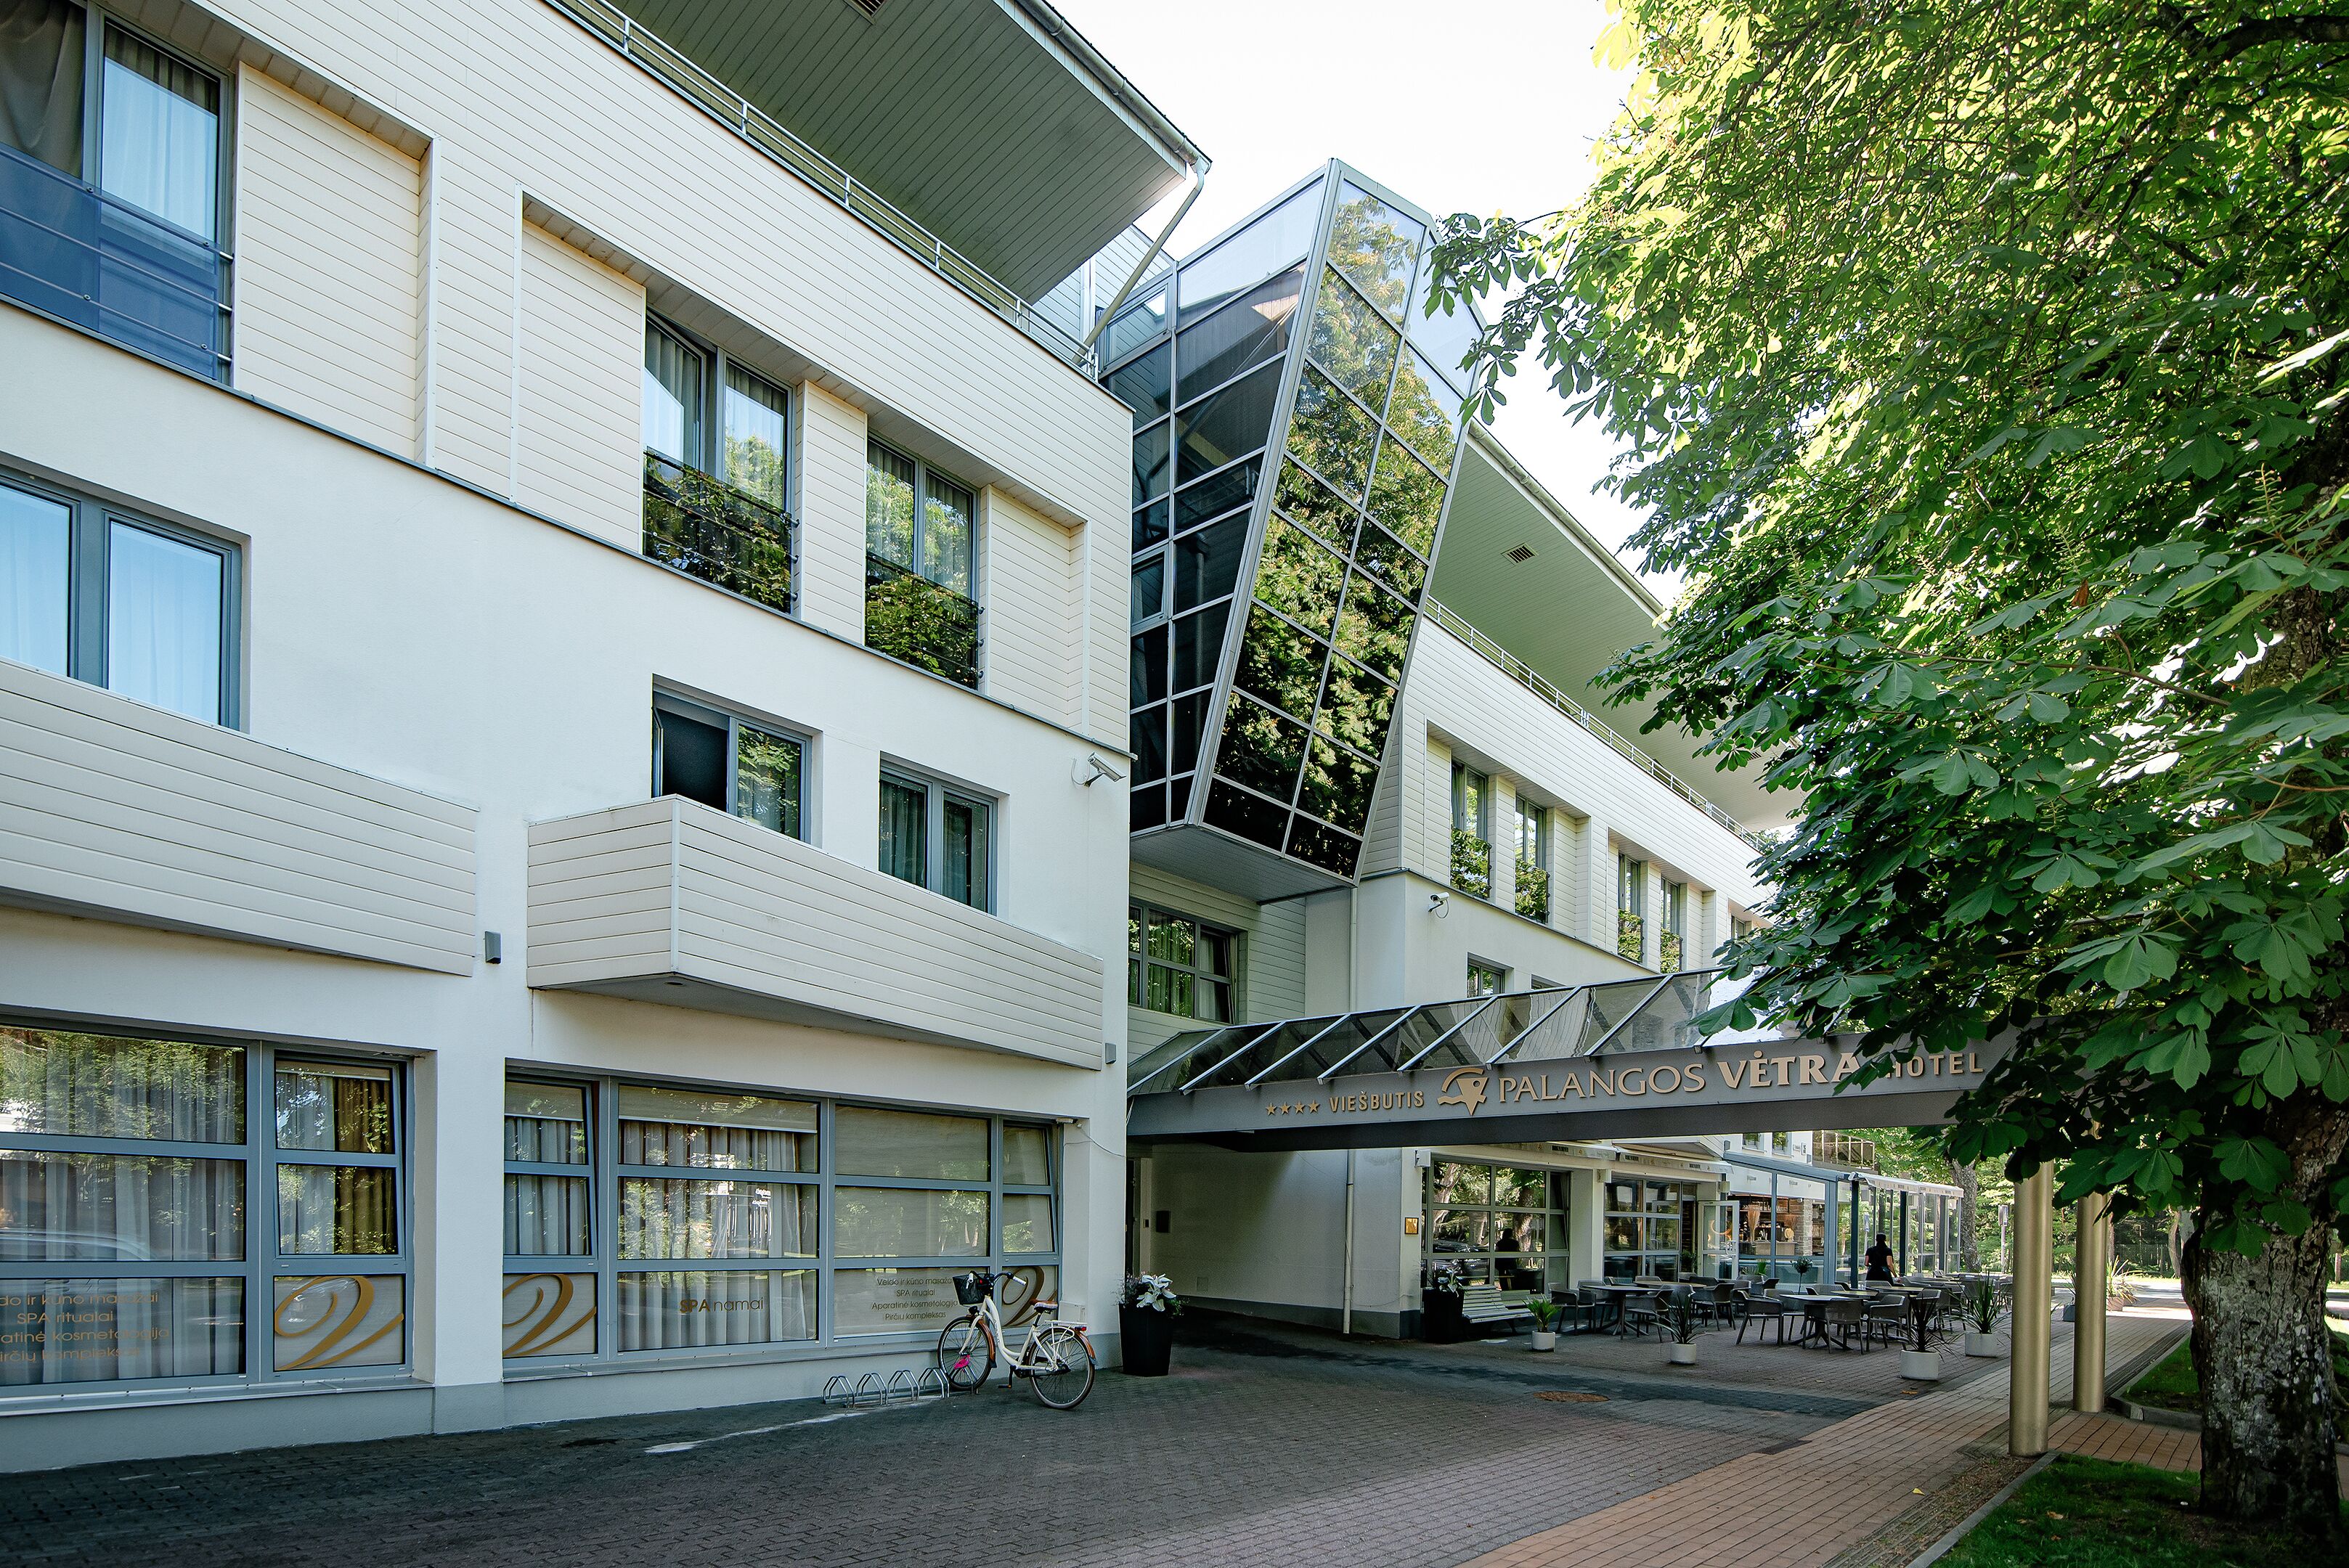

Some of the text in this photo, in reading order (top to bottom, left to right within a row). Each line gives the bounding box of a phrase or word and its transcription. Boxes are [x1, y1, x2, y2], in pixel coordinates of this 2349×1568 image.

[1329, 1090, 1425, 1112] VIEŠBUTIS
[1498, 1063, 1706, 1103] PALANGOS
[1717, 1050, 1860, 1089] VĖTRA
[28, 1294, 36, 1305] ir
[680, 1297, 763, 1313] SPA namai
[871, 1299, 958, 1310] Aparatinė kosmetologija
[17, 1311, 113, 1324] SPA ritualai
[0, 1331, 46, 1344] atinė
